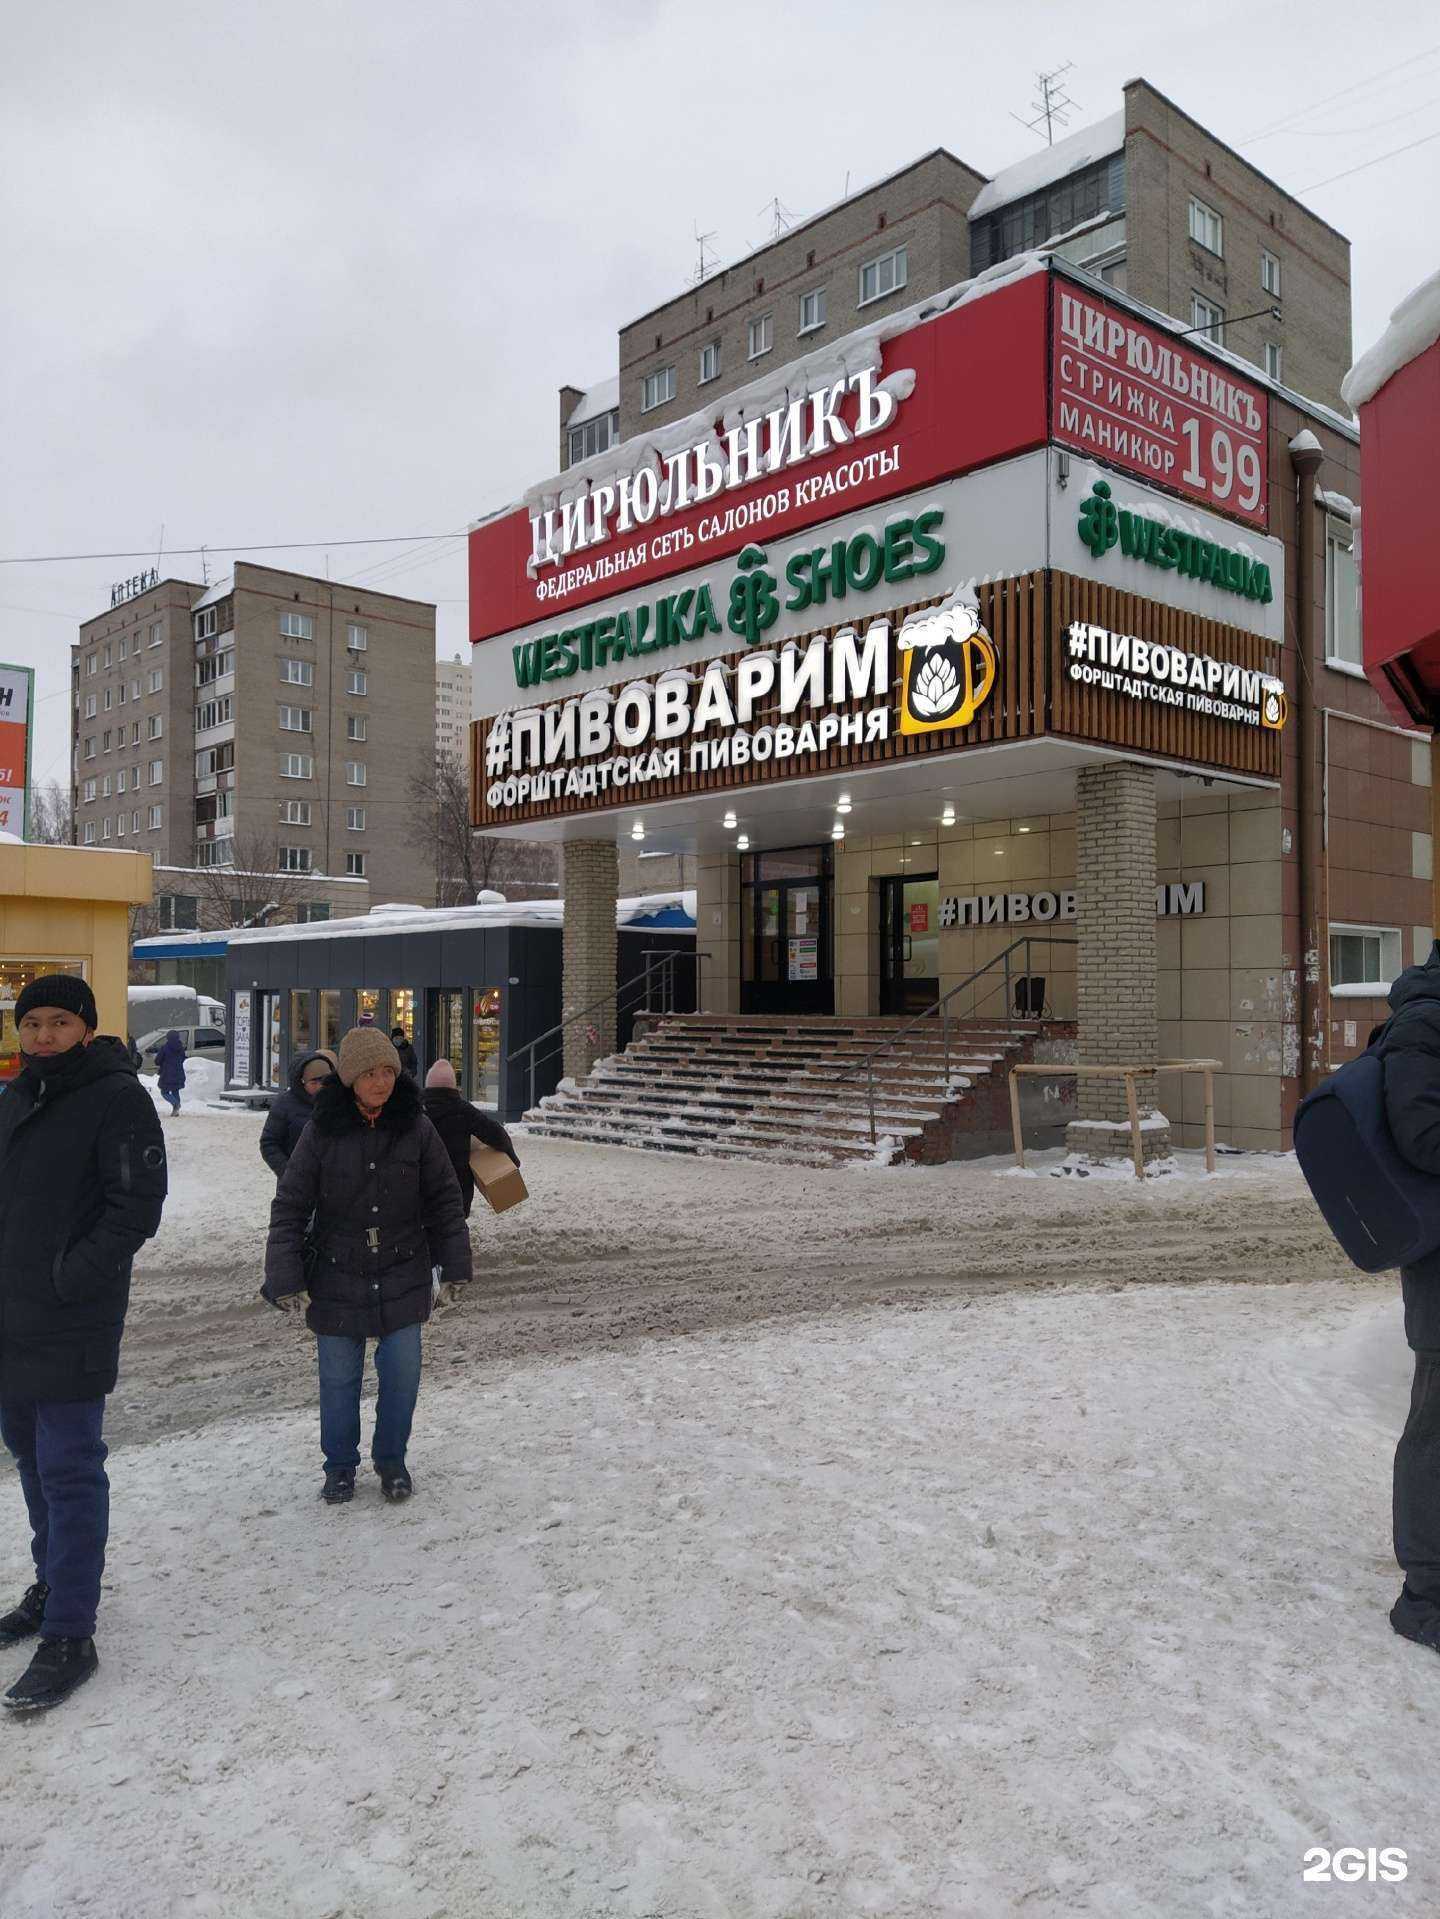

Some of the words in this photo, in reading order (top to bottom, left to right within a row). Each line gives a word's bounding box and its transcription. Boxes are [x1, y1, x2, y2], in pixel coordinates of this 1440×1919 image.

[1060, 354, 1175, 433] СТРИЖКА
[1061, 293, 1263, 433] ЦИРЮЛЬНИКЪ
[530, 365, 893, 567] ЦИРЮЛЬНИКЪ
[1060, 401, 1175, 474] МАНИКЮР
[1181, 417, 1262, 512] 199
[535, 542, 647, 601] ФЕДЕРАЛЬНАЯ
[651, 526, 694, 559] СЕТЬ
[698, 489, 790, 541] САЛОНОВ
[795, 444, 900, 508] КРАСОТЫ
[1118, 509, 1274, 605] WESTFALIKA
[512, 582, 722, 688] WESTFALIKA
[785, 509, 946, 612] SHOES
[485, 623, 890, 777] #ПИВОВАРИМ
[1068, 620, 1261, 705] #ПИВОВАРИМ
[1070, 663, 1184, 707] ФОРШТАДТСКАЯ
[1186, 693, 1260, 726] ПИВОВАРНЯ
[486, 745, 681, 809] ФОРШТАДТСКАЯ
[690, 704, 889, 772] ПИВОВАРНЯ
